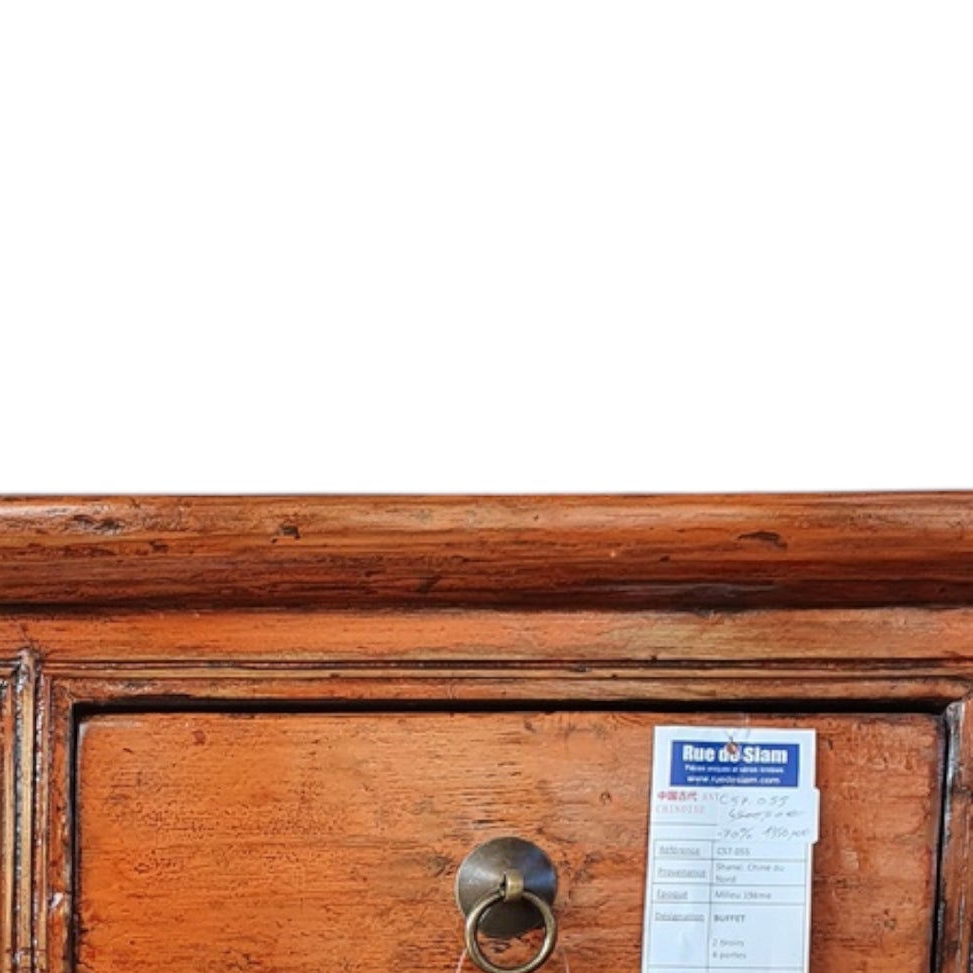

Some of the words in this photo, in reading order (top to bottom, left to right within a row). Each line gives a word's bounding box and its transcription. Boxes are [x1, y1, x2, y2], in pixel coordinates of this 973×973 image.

[682, 744, 715, 762] Rue
[743, 745, 788, 764] Siam
[713, 914, 746, 923] BUFFET
[712, 938, 718, 946] 2
[719, 951, 747, 960] portes
